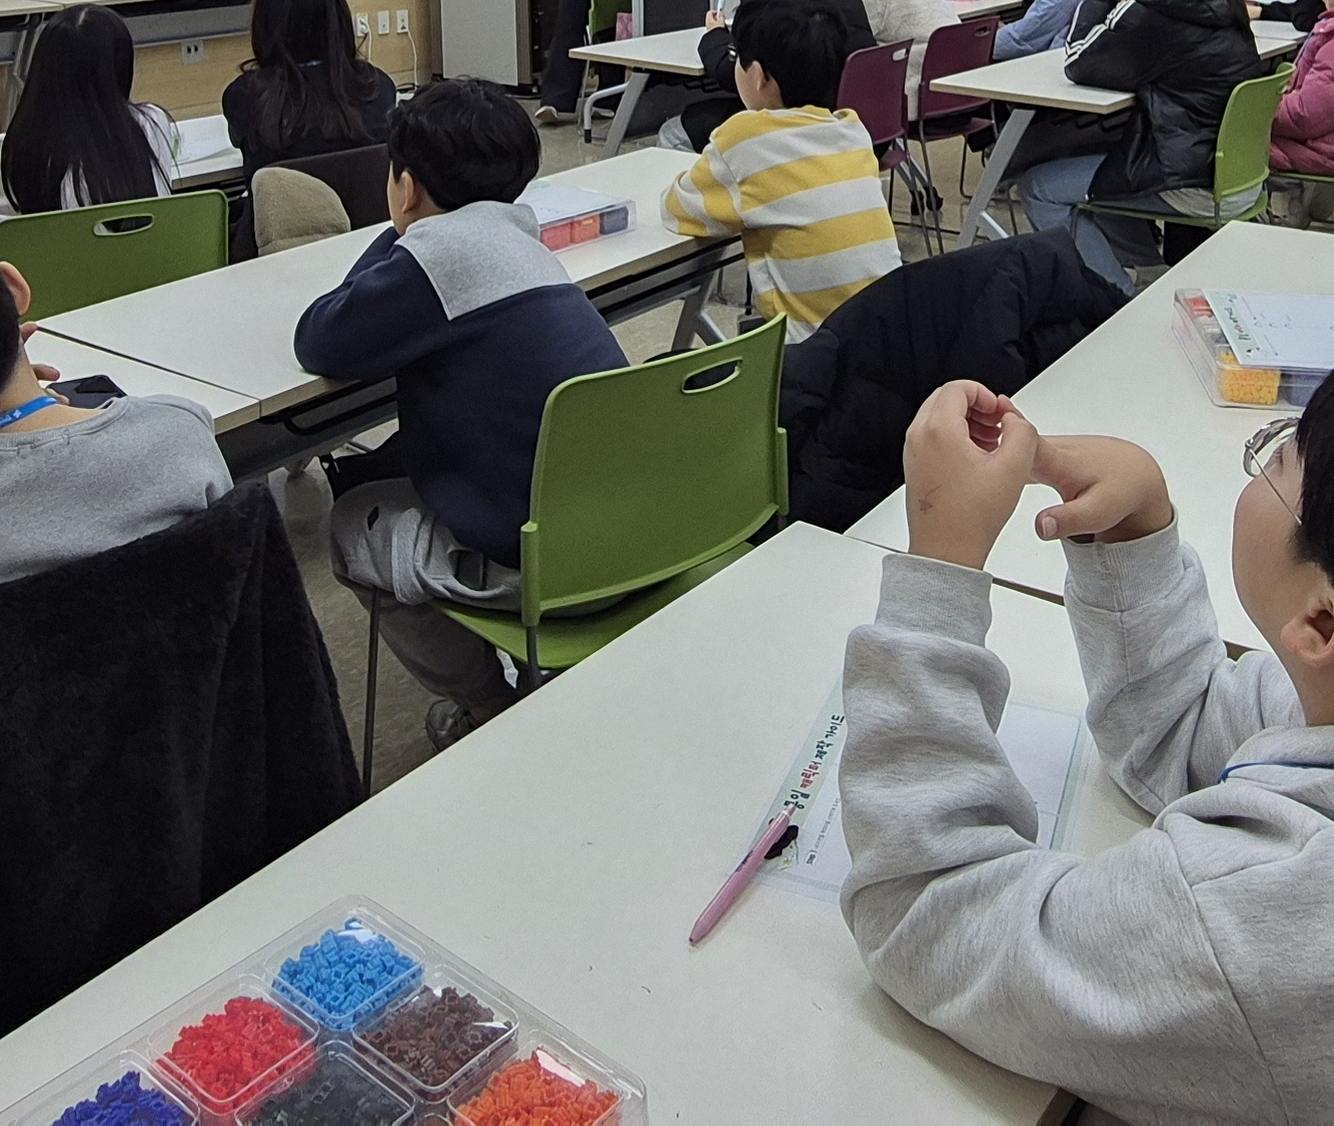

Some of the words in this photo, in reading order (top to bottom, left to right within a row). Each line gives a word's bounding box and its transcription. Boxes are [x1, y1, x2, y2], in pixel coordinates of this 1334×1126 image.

[800, 760, 822, 789] 캐릭터
[815, 740, 834, 760] 제작
[825, 714, 845, 739] 가이드
